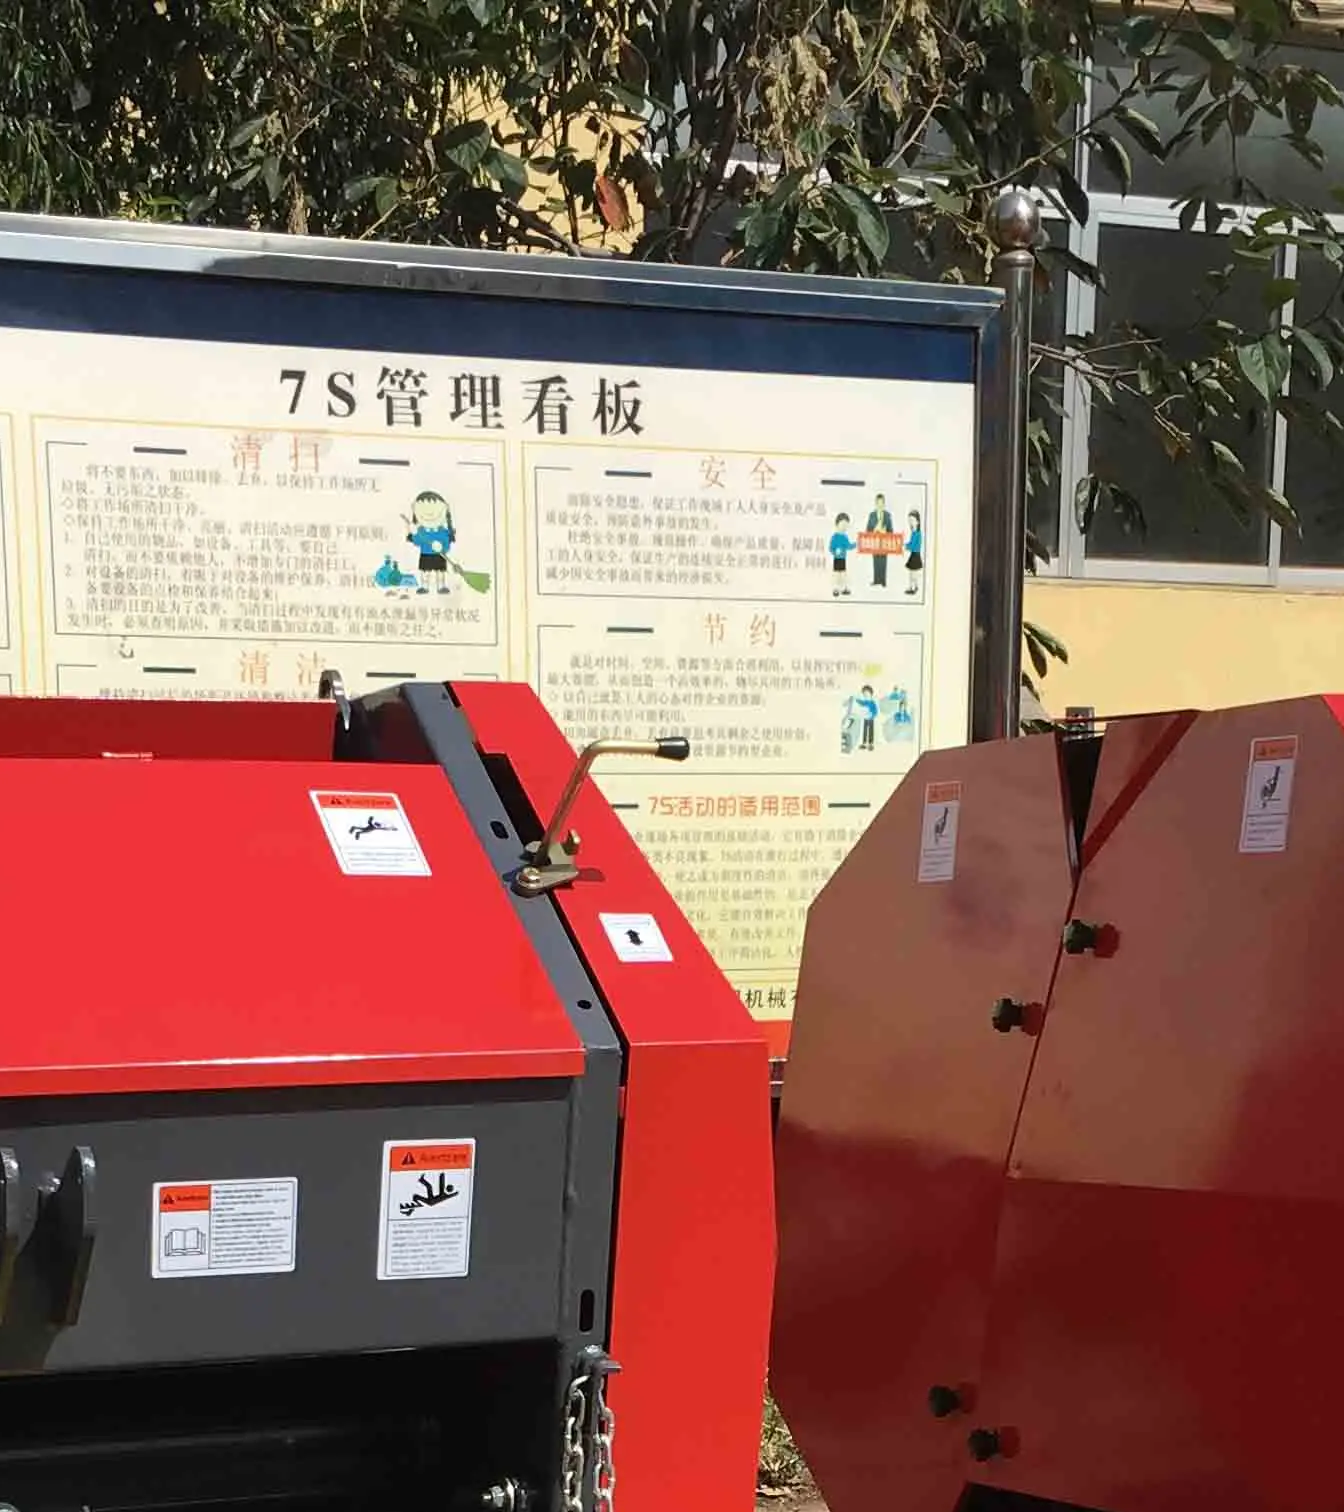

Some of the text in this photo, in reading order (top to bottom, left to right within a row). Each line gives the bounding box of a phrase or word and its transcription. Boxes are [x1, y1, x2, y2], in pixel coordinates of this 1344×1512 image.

[279, 367, 645, 436] 7S管理看板
[231, 432, 322, 474] 清扫
[700, 455, 778, 491] 安全
[701, 613, 778, 649] 节约
[648, 795, 822, 818] 7S活动的适用范围
